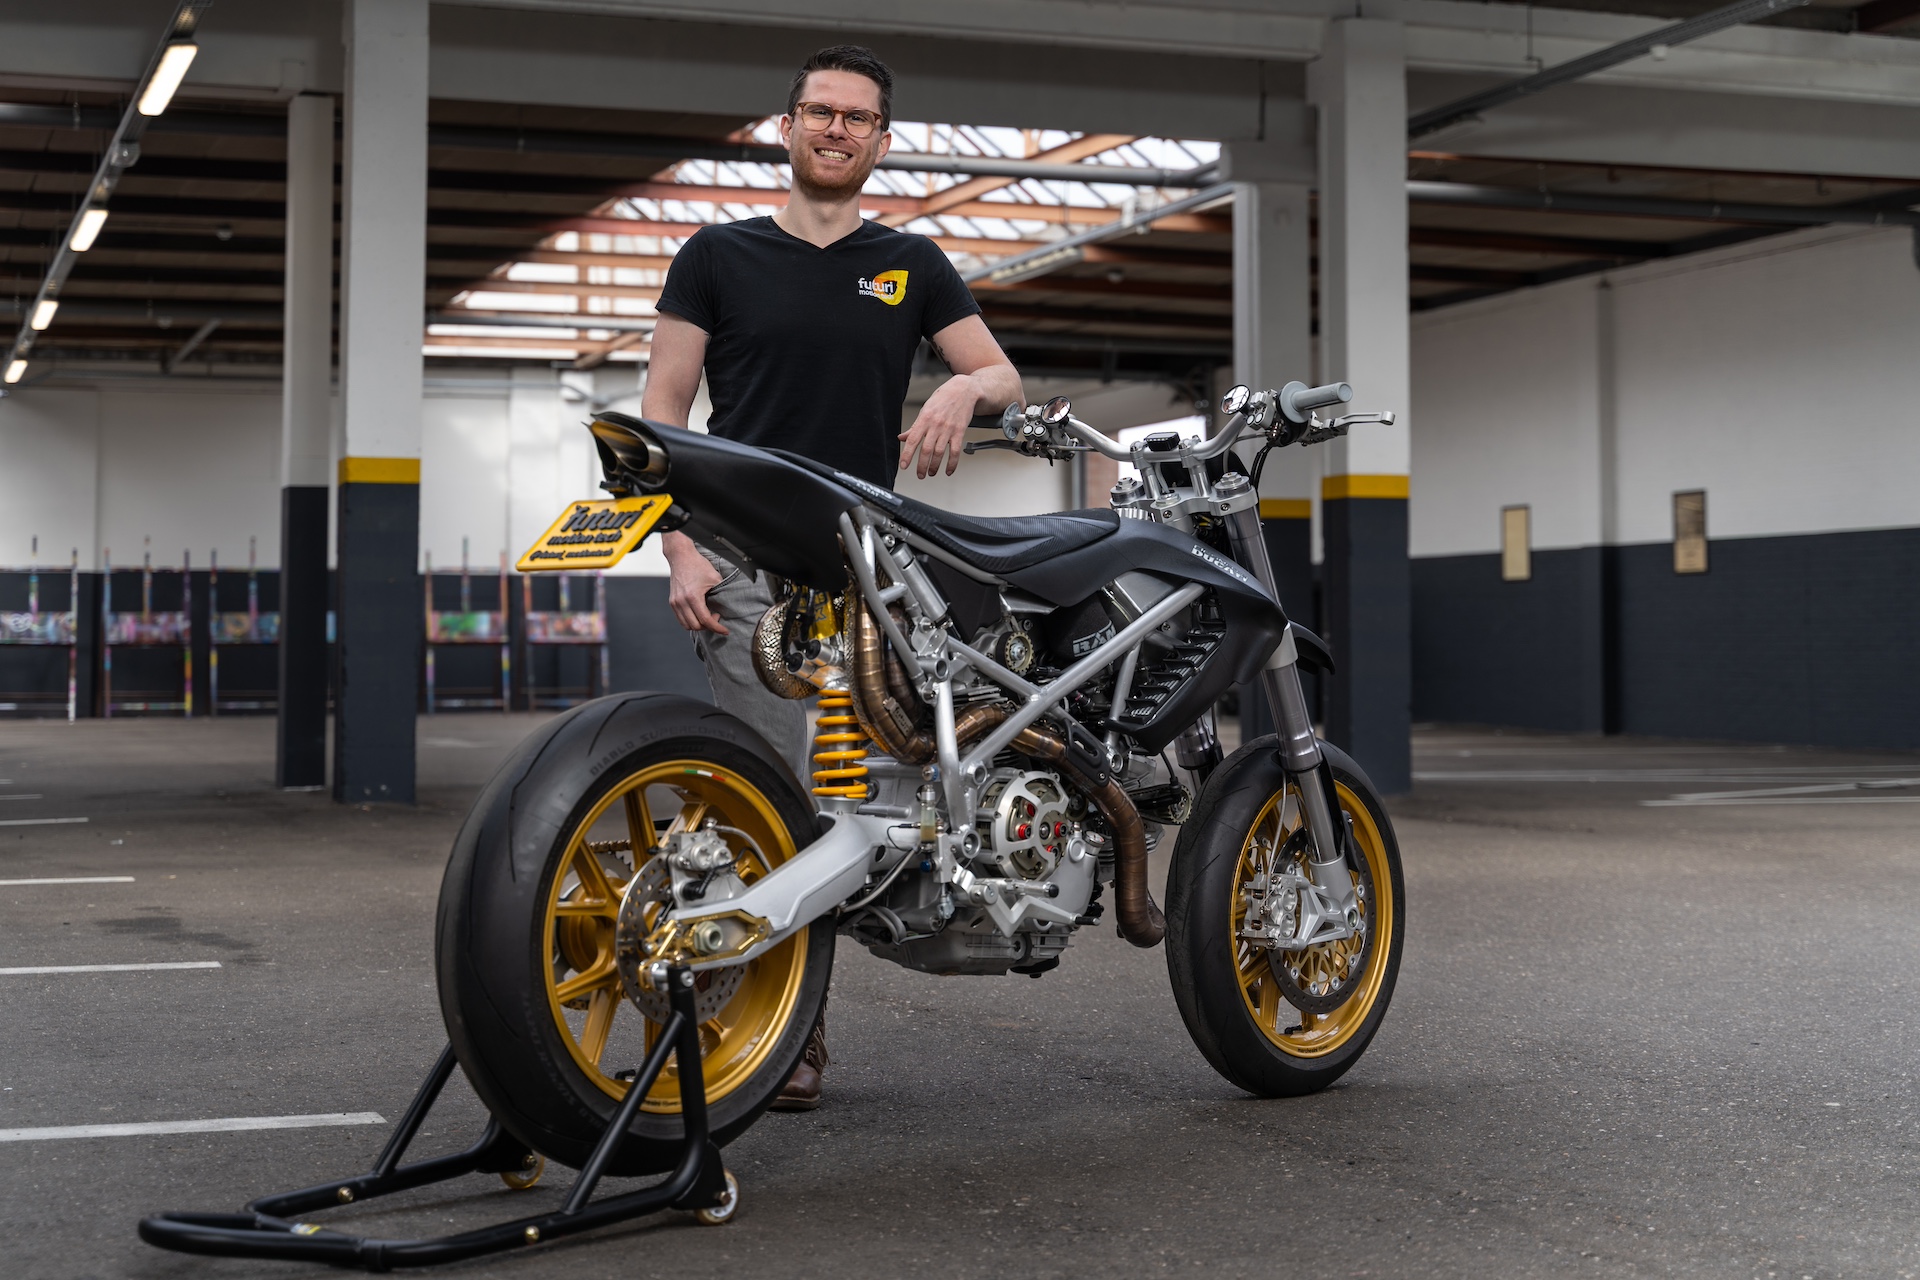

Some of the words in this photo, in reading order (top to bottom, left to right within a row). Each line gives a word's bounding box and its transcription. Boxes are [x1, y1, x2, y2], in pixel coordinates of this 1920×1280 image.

[858, 277, 894, 293] futuri
[561, 504, 648, 533] futuri
[547, 532, 594, 545] motion
[594, 530, 622, 543] tech
[589, 740, 636, 777] DIABLO
